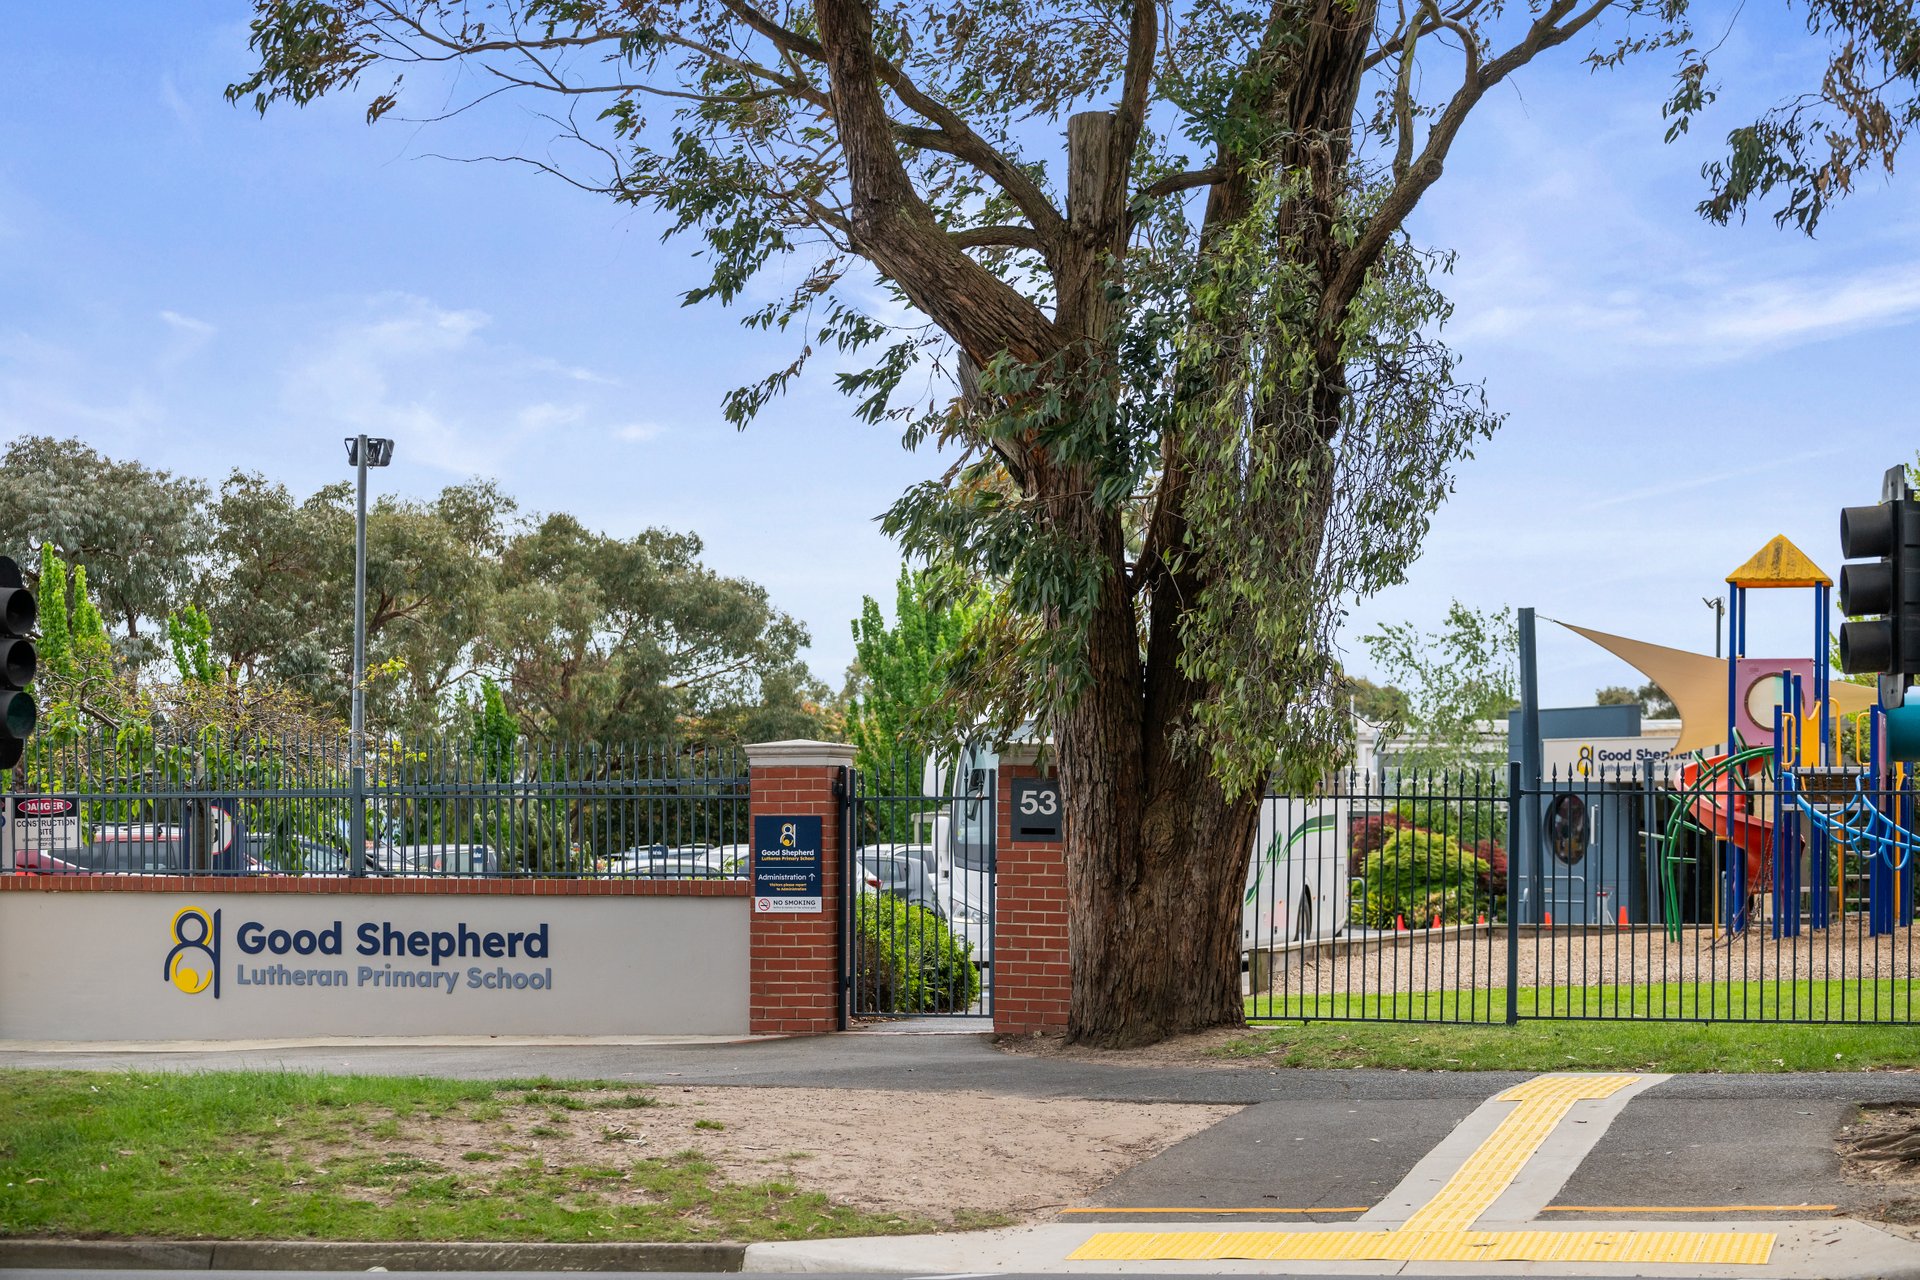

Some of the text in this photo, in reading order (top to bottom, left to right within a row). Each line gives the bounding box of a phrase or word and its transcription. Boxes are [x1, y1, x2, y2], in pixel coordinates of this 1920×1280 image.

[1598, 748, 1632, 762] Good
[1020, 790, 1057, 815] 53
[781, 849, 814, 857] Shepherd
[758, 873, 807, 881] Administration
[236, 921, 549, 966] Good Shepherd
[237, 963, 552, 994] Lutheran Primary School
